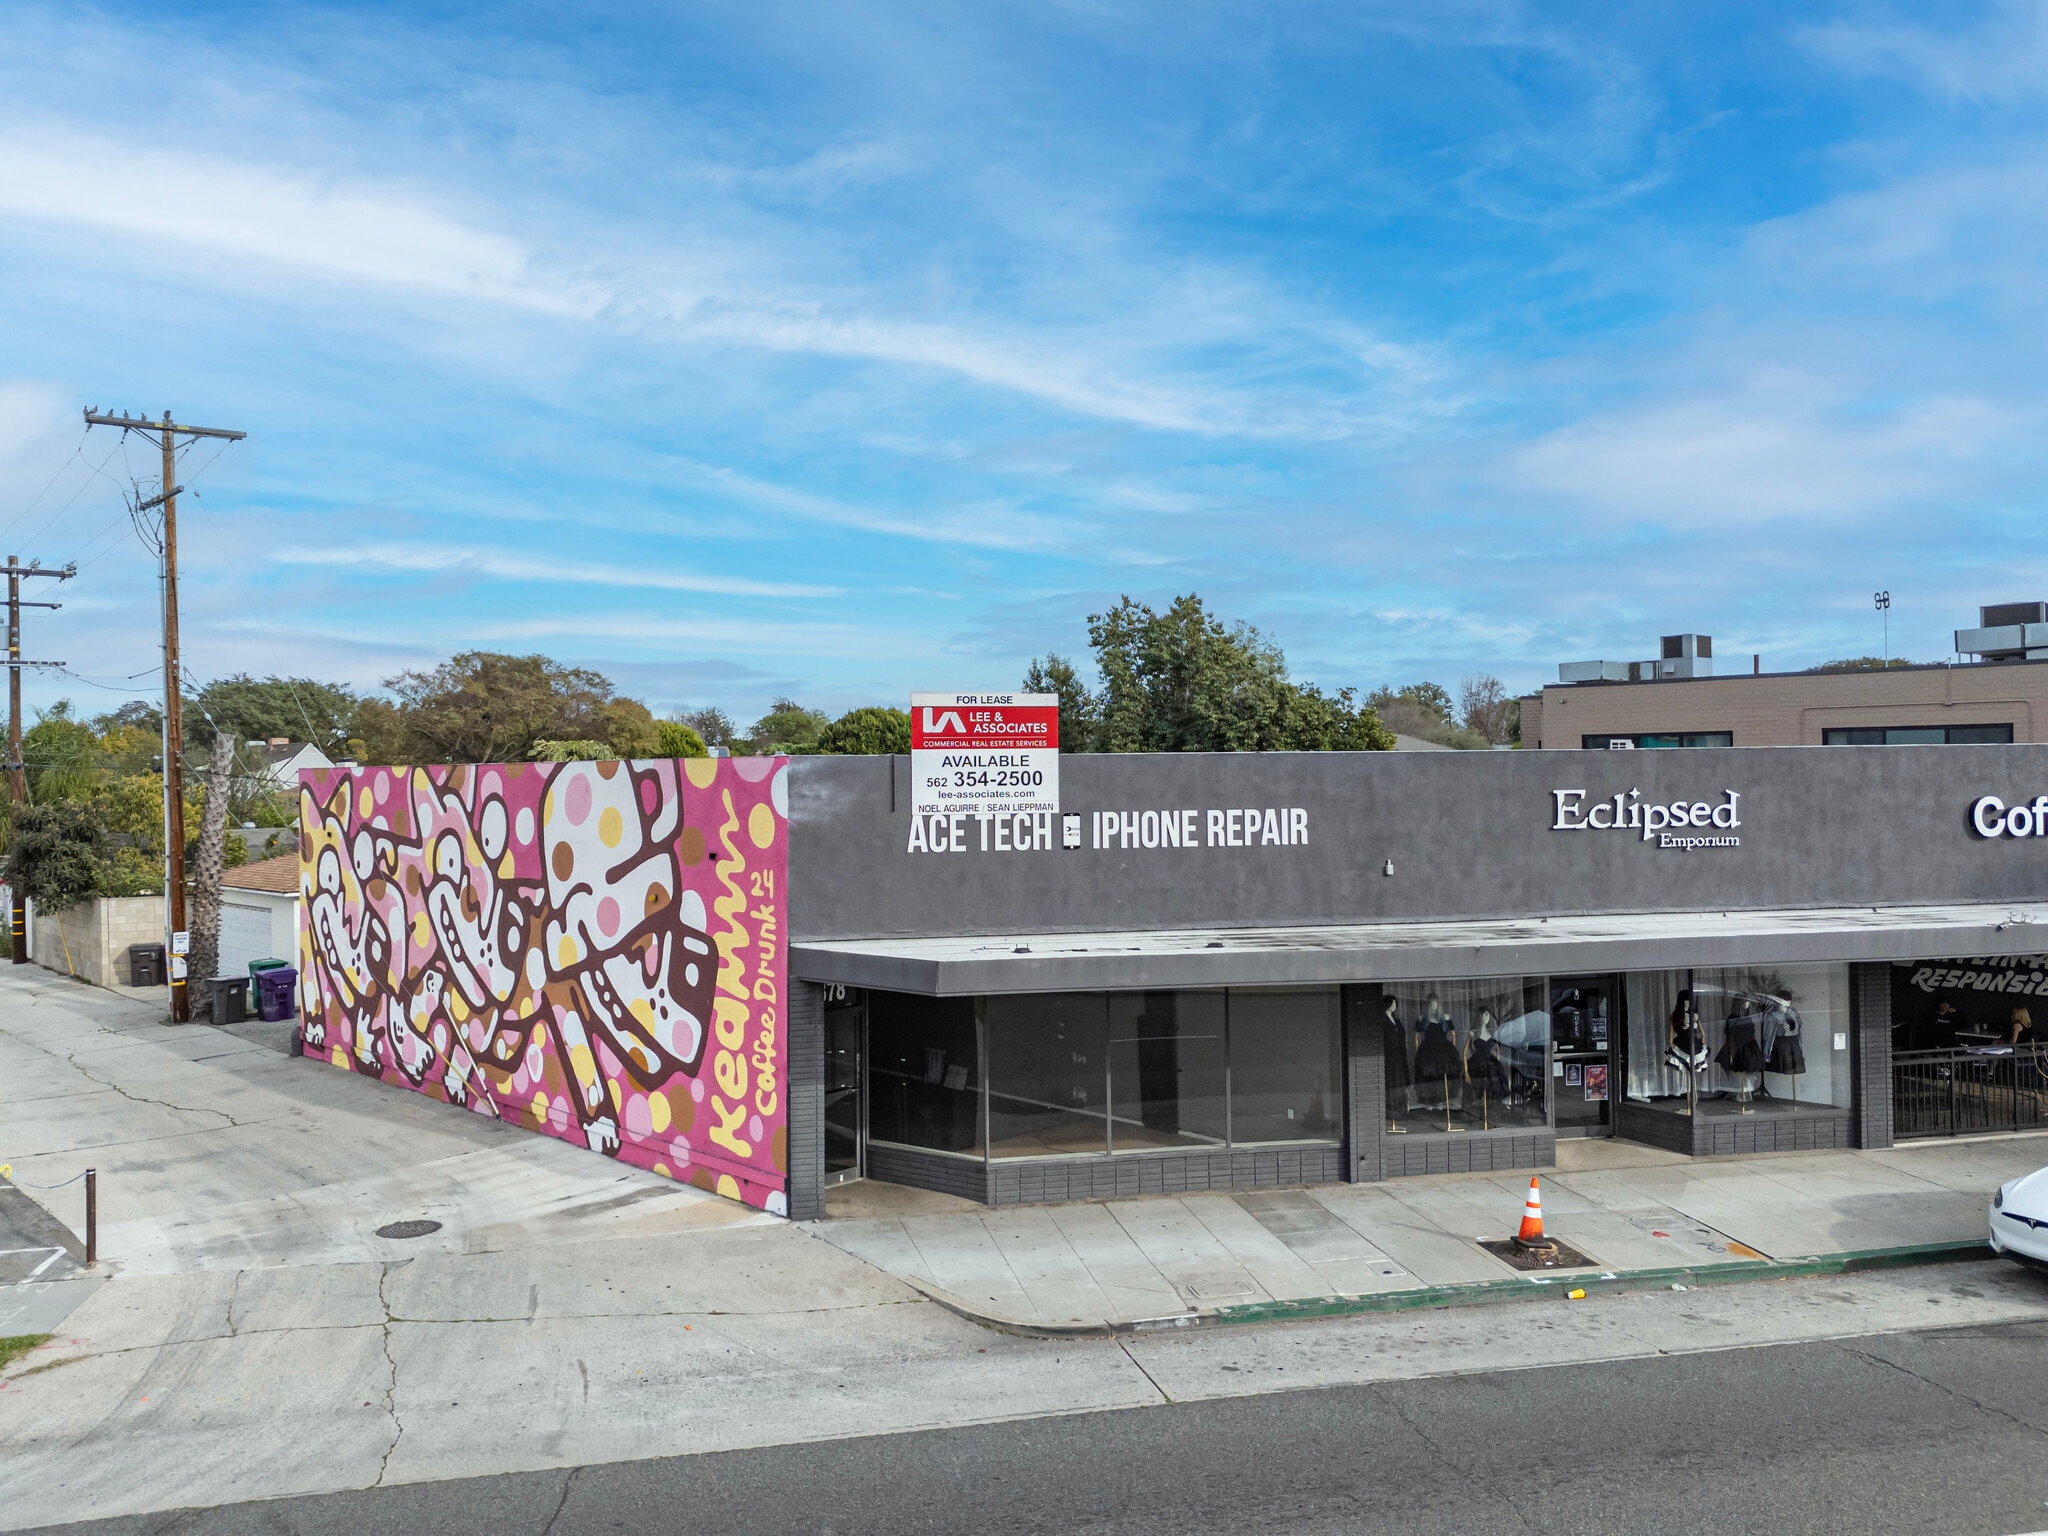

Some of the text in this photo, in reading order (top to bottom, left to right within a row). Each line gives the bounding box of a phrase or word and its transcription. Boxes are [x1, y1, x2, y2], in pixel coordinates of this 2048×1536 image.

[956, 695, 1013, 705] FOR LEASE
[969, 711, 1003, 722] LEE &
[973, 722, 1048, 734] ASSOCIATES
[923, 740, 970, 748] COMMERCIAL
[1015, 739, 1047, 747] SERVICES
[941, 754, 1030, 768] AVAILABLE
[926, 770, 1043, 788] 562 354-2500
[938, 789, 1036, 799] lee-associates.com
[918, 804, 941, 813] NOEL
[943, 804, 980, 812] AGUIRRE
[987, 803, 1010, 812] SEAN
[1012, 802, 1054, 811] LIEPPMAN
[1552, 786, 1742, 842] Eclipsed
[908, 808, 1309, 853] ACE TECH IPHONE REPAIR
[1659, 833, 1740, 852] Emporium
[749, 904, 777, 1005] Drunk
[823, 982, 846, 1002] 78
[751, 1006, 778, 1116] Coffee
